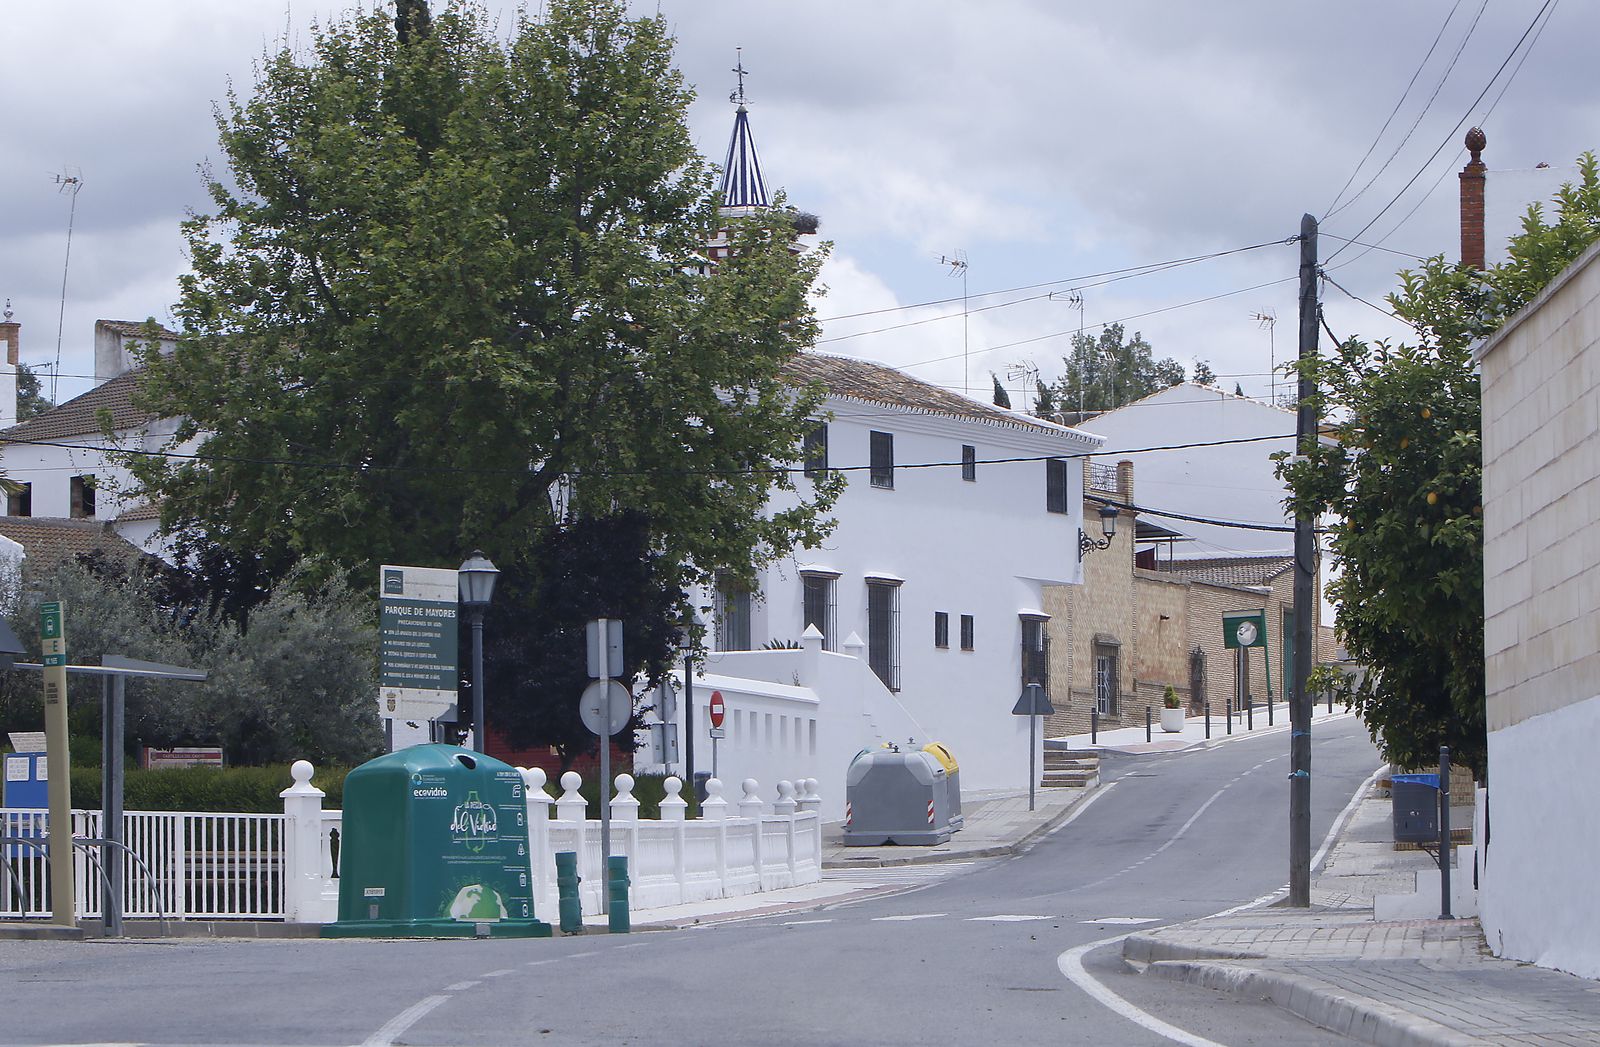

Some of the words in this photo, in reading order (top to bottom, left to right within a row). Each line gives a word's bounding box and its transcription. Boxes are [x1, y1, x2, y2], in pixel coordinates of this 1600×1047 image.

[385, 606, 412, 616] PARQUE
[414, 607, 424, 616] DE
[425, 608, 456, 618] MAYORES
[413, 787, 448, 797] ecovidrio
